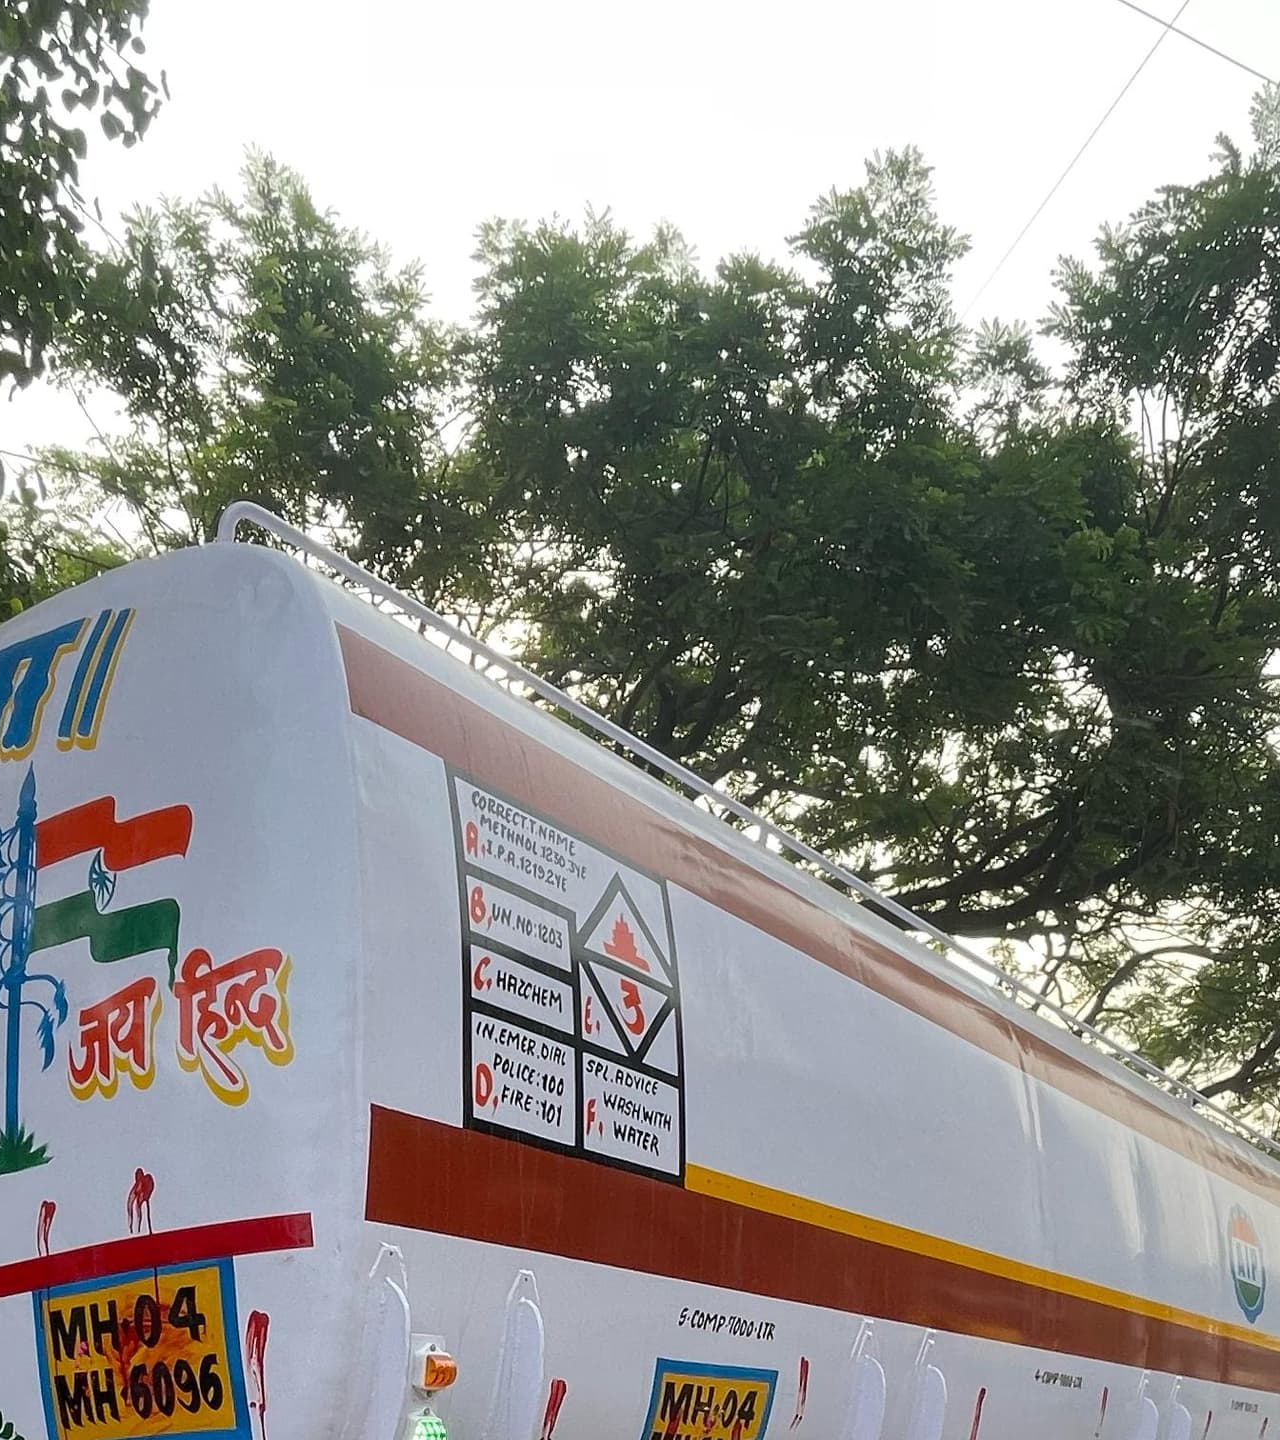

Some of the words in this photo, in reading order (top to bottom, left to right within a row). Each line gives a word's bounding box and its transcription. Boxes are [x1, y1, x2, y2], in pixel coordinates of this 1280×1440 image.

[497, 969, 562, 1013] HAZCHEM
[621, 978, 646, 1036] 3
[69, 976, 162, 1099] जय
[173, 948, 294, 1106] हिन्द
[612, 1120, 660, 1157] WATER
